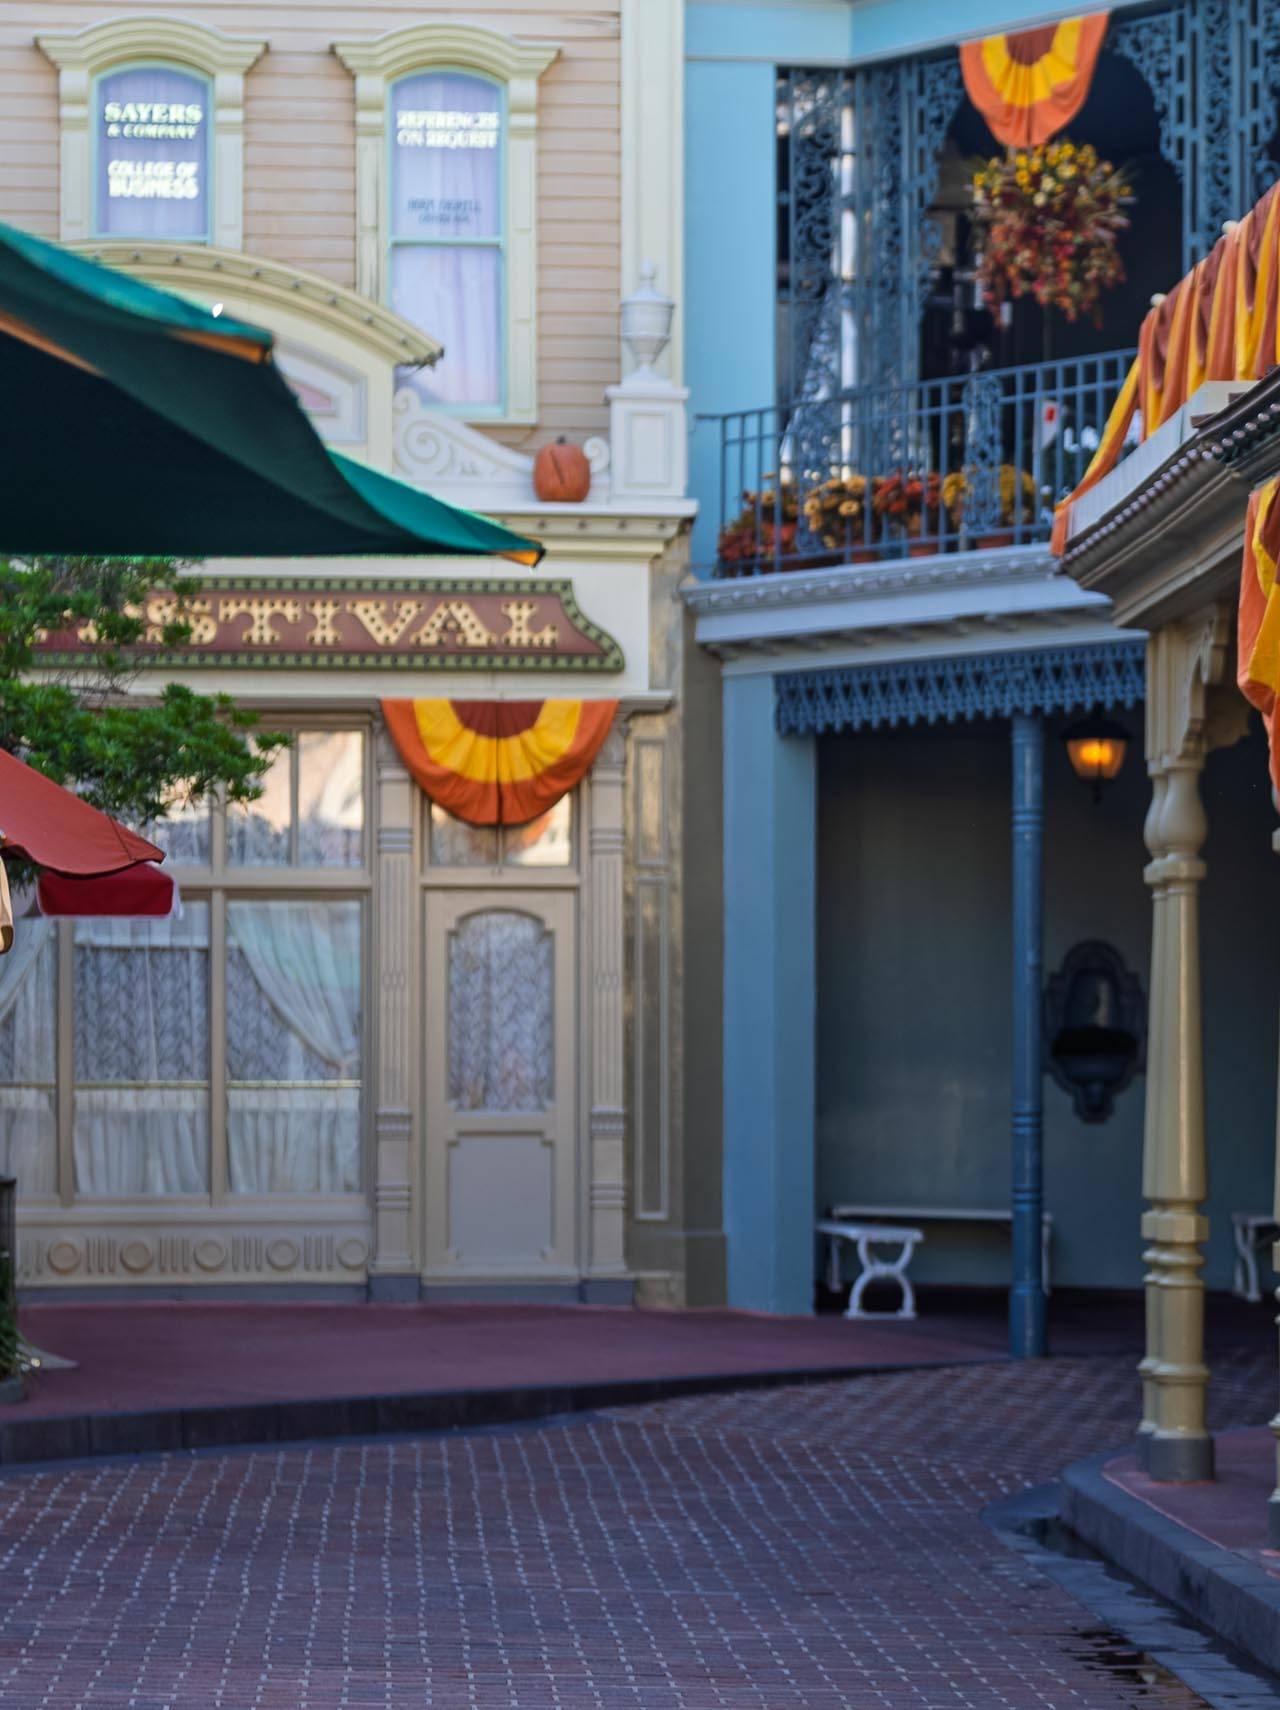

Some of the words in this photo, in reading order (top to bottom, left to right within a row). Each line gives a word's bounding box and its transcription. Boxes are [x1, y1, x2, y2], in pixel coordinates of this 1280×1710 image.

[104, 102, 203, 124] SAYERS
[123, 124, 197, 139] COMPANY
[108, 160, 175, 178] COLLEGE
[176, 161, 199, 178] OF
[109, 177, 199, 199] BUSINESS
